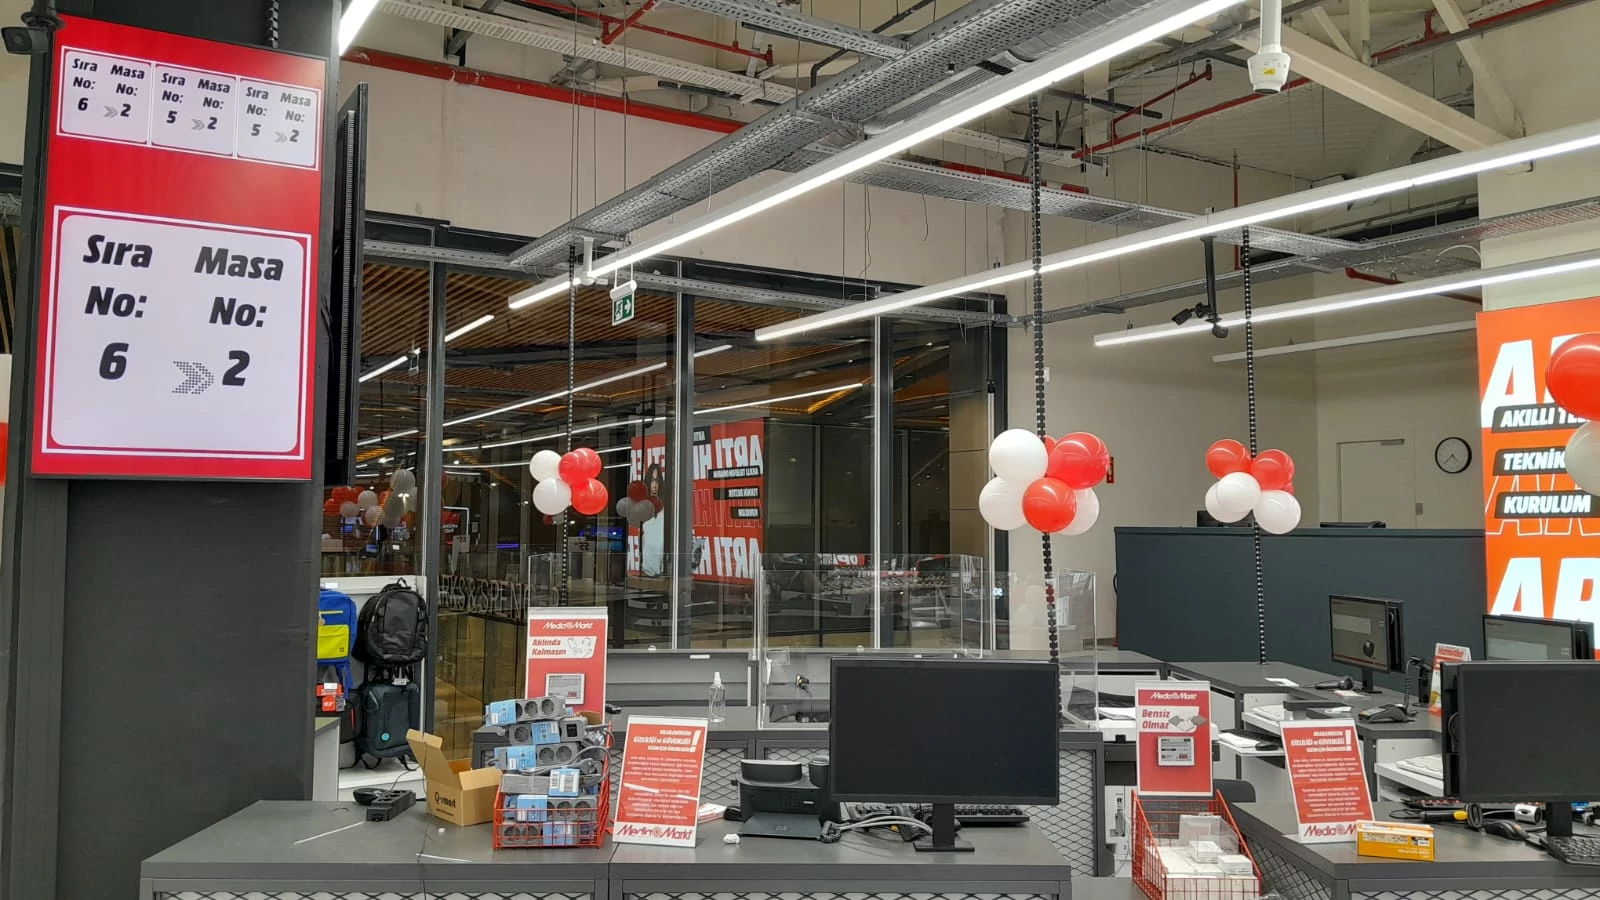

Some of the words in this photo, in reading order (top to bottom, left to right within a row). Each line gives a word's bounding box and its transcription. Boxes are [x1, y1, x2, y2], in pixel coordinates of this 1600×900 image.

[110, 64, 145, 79] Masa
[73, 76, 95, 89] No:
[116, 83, 138, 96] No:
[197, 79, 231, 94] Masa
[77, 97, 89, 111] 6
[120, 103, 131, 117] 2
[162, 90, 184, 103] No:
[202, 97, 225, 110] No:
[279, 92, 312, 107] Masa
[166, 110, 178, 124] 5
[207, 117, 218, 130] 2
[246, 104, 268, 117] No:
[285, 110, 305, 123] No:
[251, 123, 262, 136] 5
[289, 129, 300, 142] 2
[82, 234, 153, 268] Sıra
[194, 246, 285, 281] Masa
[84, 285, 148, 318] No:
[208, 296, 268, 328] No:
[99, 342, 130, 380] 6
[222, 350, 250, 387] 2
[1501, 407, 1555, 428] AKILLI
[1503, 449, 1566, 471] TEKNİK
[1504, 495, 1592, 514] KURULUM
[1142, 709, 1170, 718] Bensiz
[1142, 720, 1169, 730] Olmaz
